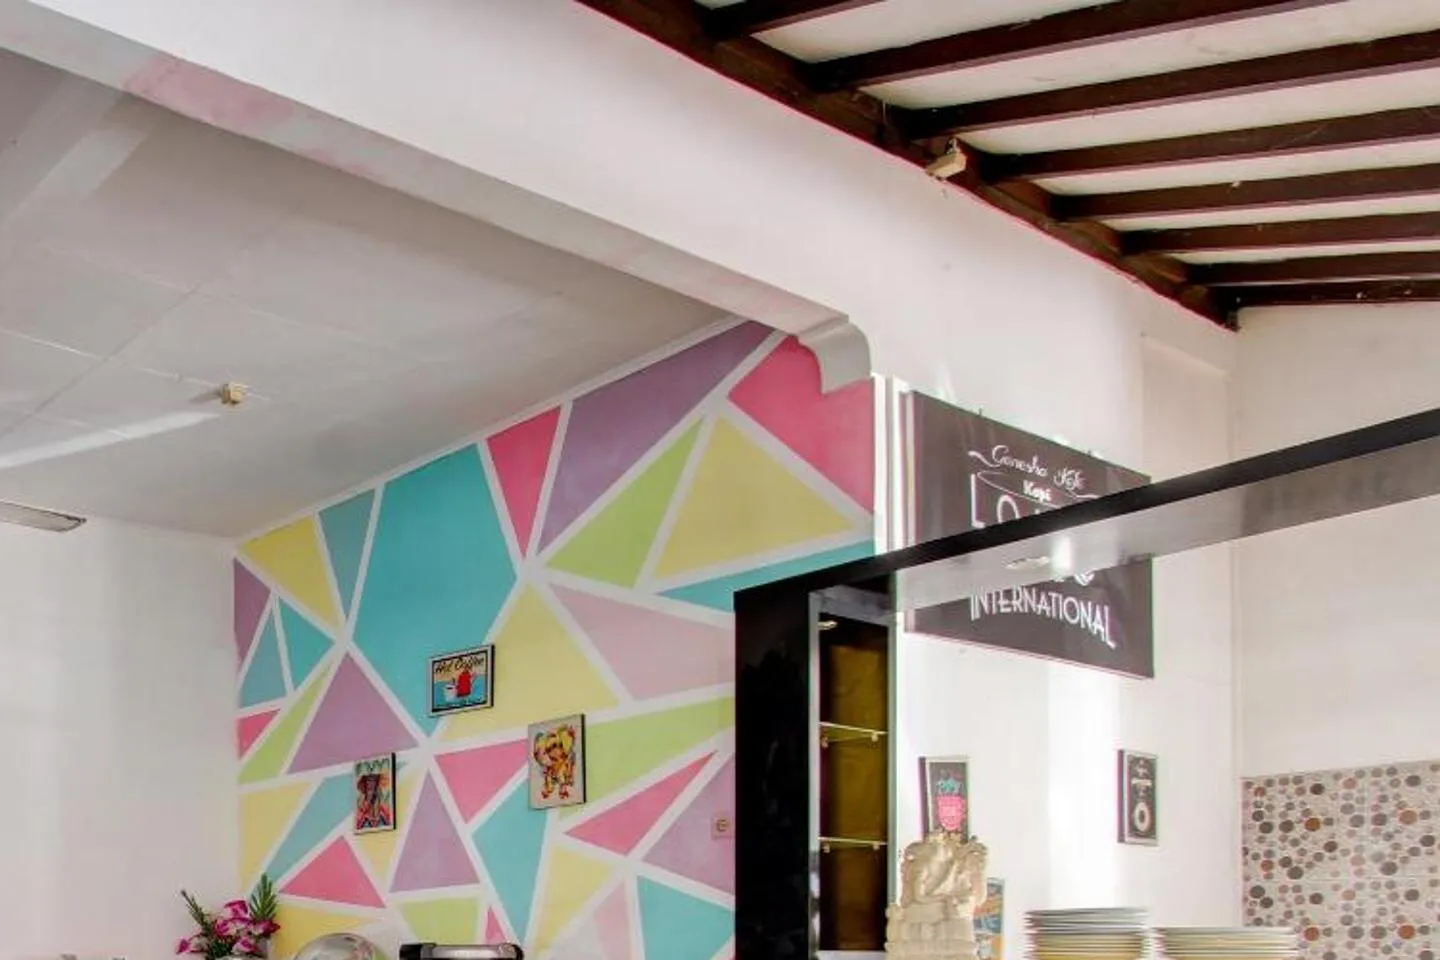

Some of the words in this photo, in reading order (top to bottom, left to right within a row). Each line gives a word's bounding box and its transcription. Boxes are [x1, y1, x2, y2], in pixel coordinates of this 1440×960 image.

[986, 444, 1048, 477] Ganesha
[1022, 479, 1053, 503] Kopi
[970, 584, 1116, 649] INTERNATIONAL
